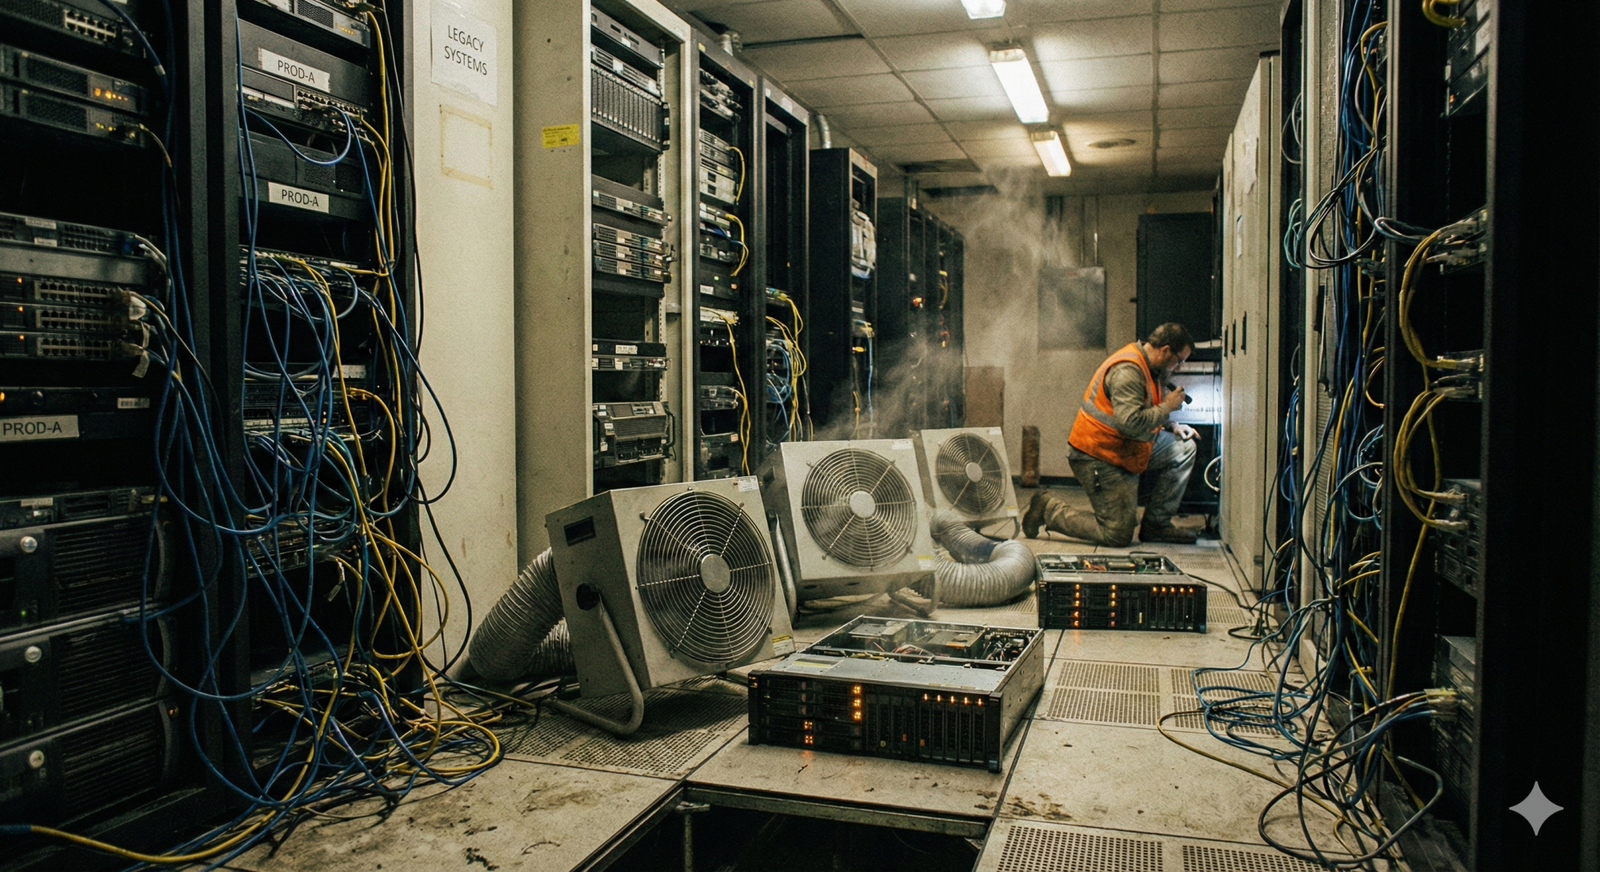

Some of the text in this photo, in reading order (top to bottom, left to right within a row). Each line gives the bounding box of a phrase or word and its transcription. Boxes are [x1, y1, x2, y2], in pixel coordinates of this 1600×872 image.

[447, 24, 485, 53] LEGACY
[277, 60, 315, 83] PROD-A
[444, 45, 488, 76] SYSTEMS
[281, 189, 319, 207] PROD-A
[2, 421, 63, 436] PROD-A
